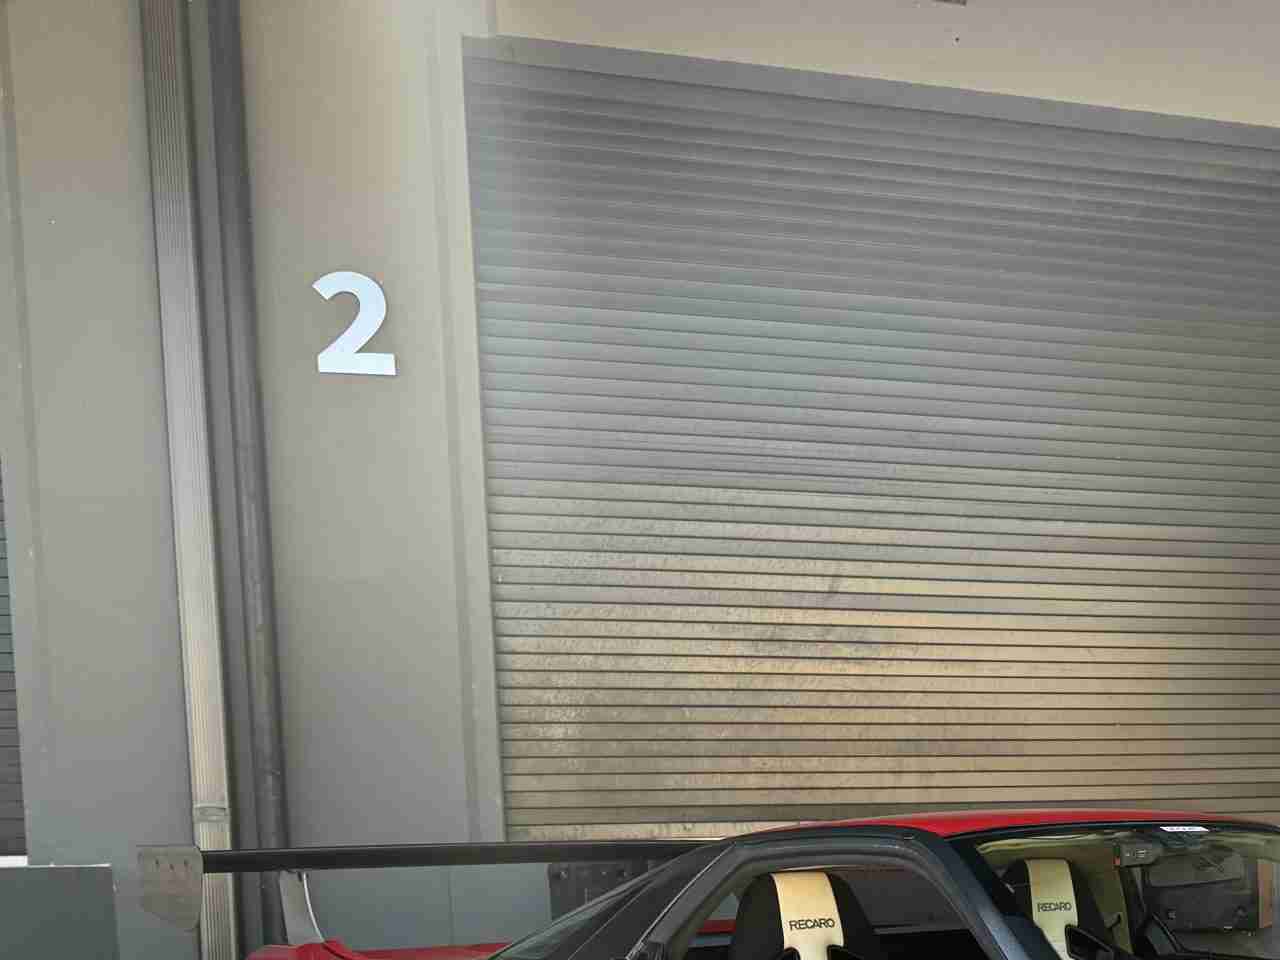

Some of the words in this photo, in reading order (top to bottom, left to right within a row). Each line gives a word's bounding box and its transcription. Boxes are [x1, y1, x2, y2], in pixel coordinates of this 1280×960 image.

[311, 270, 396, 376] 2
[1036, 901, 1072, 912] RECARO
[788, 917, 836, 931] RECARO
